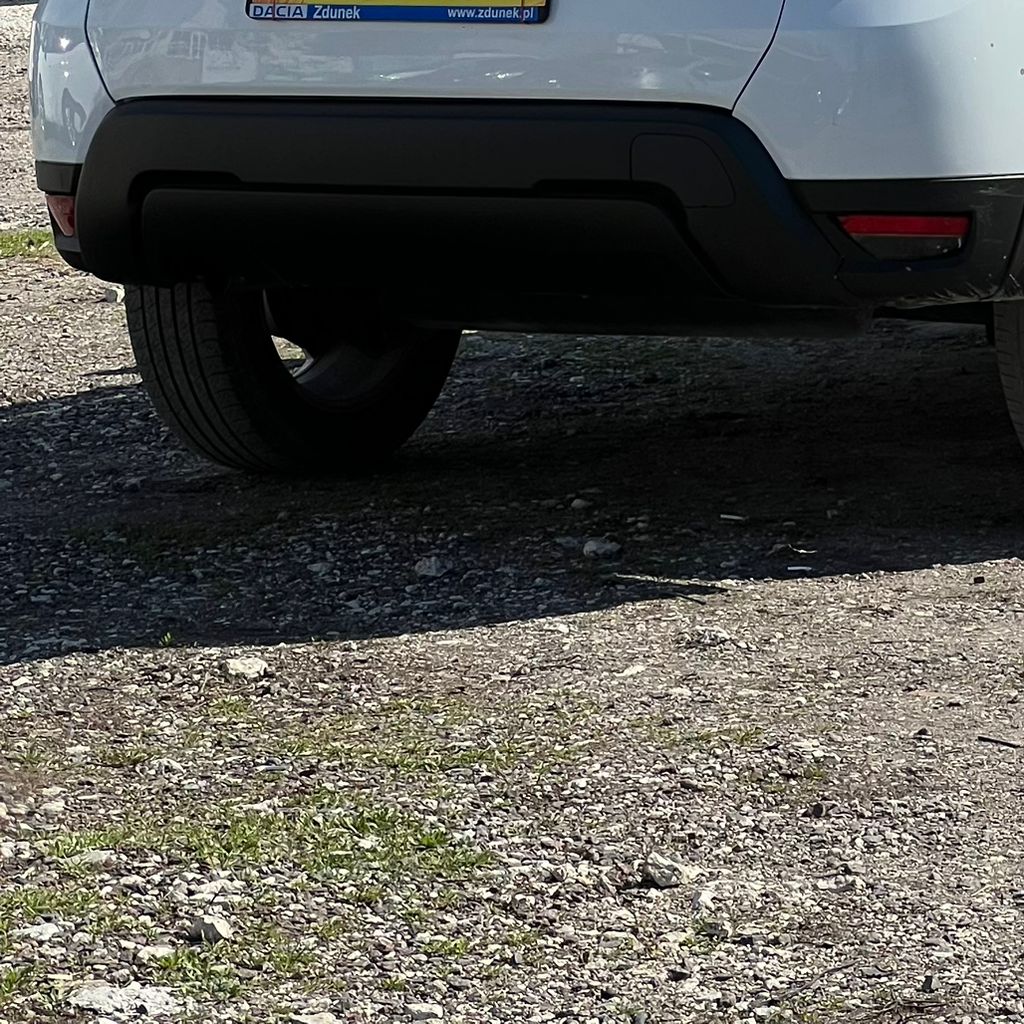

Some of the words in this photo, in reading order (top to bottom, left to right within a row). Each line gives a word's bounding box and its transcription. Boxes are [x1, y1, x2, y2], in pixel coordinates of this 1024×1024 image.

[253, 6, 306, 18] DACIA
[312, 5, 361, 20] Zdunek
[447, 6, 534, 19] www.zdunek.pl
